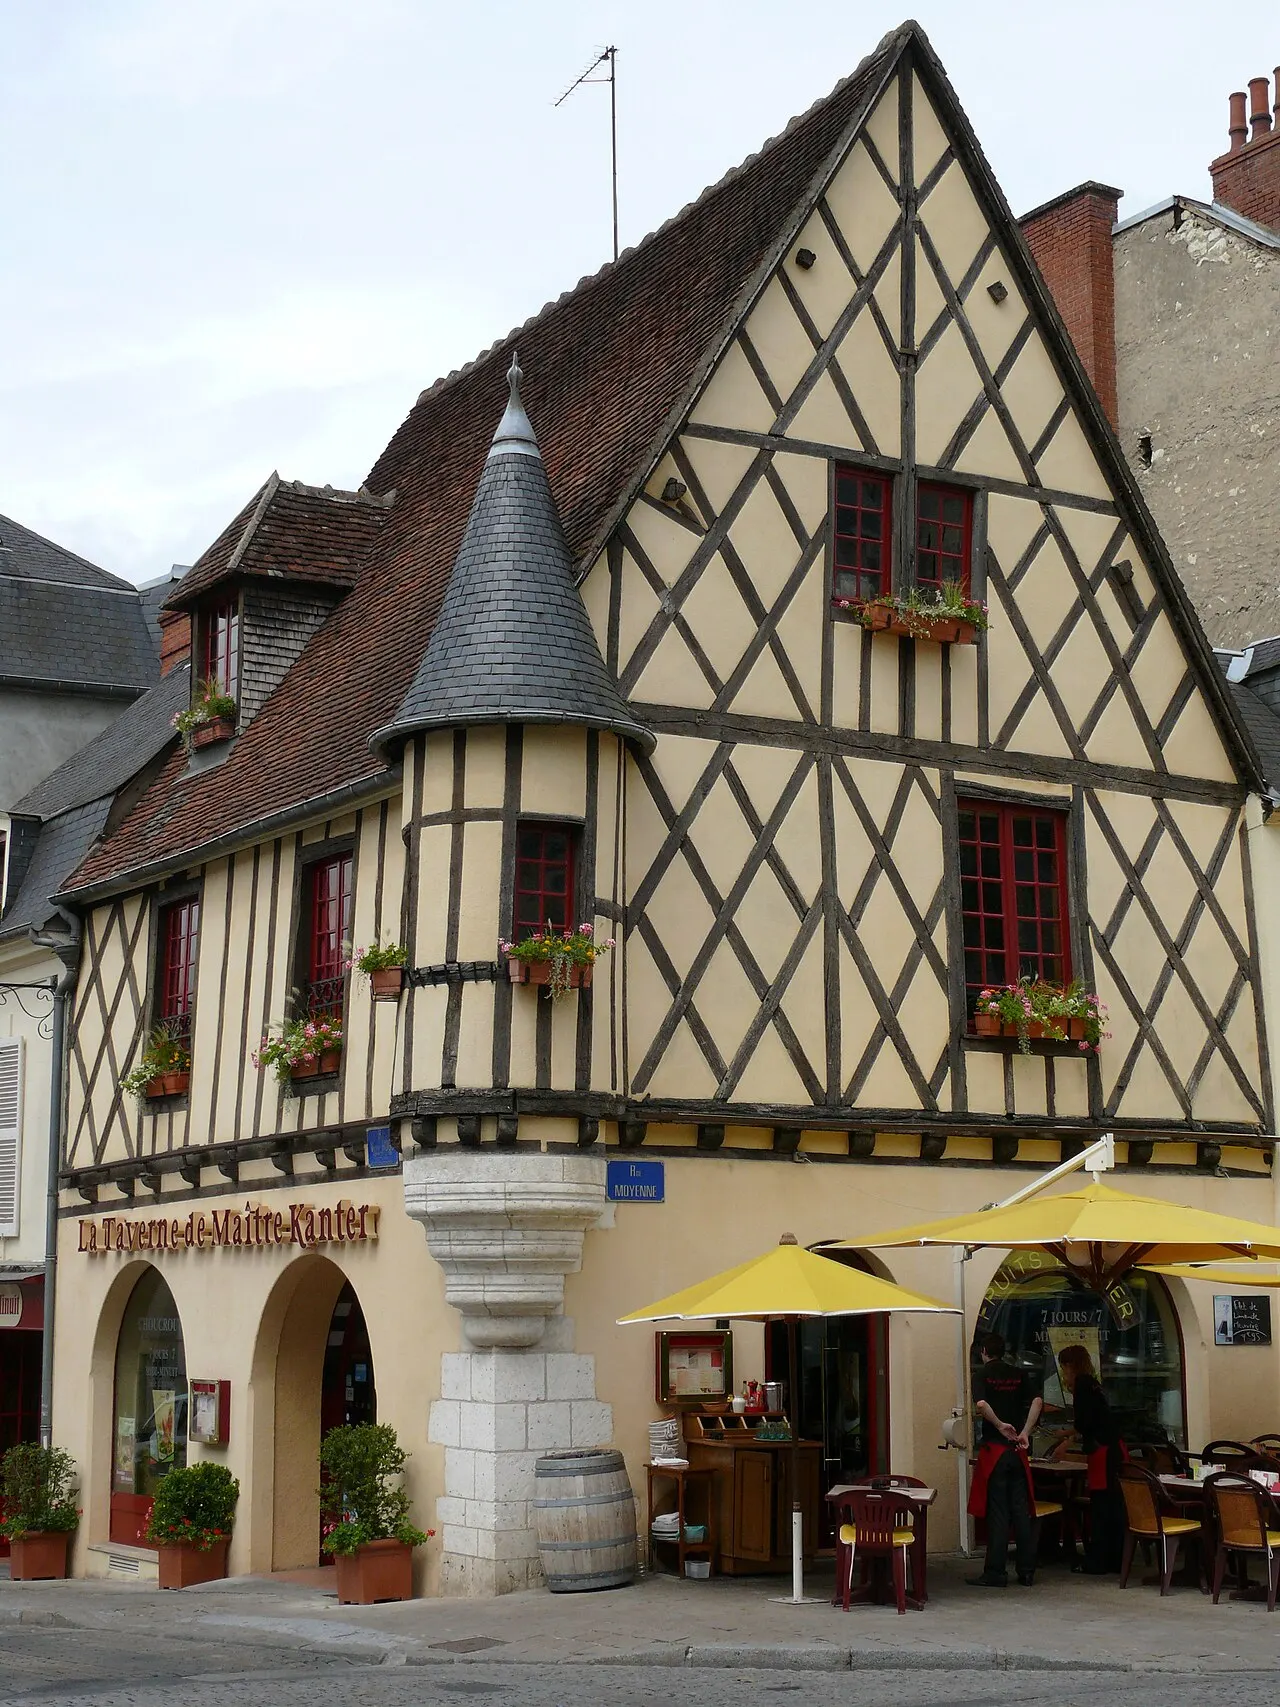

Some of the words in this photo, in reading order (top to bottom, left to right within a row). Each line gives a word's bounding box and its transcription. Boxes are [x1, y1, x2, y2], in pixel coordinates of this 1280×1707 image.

[614, 1184, 657, 1198] MOYENNE
[78, 1219, 98, 1252] La
[102, 1216, 179, 1251] Taverne
[184, 1211, 206, 1247] de
[211, 1200, 283, 1246] Maître
[288, 1199, 370, 1249] Kanter
[0, 1294, 20, 1315] inuit
[1040, 1309, 1048, 1323] 7
